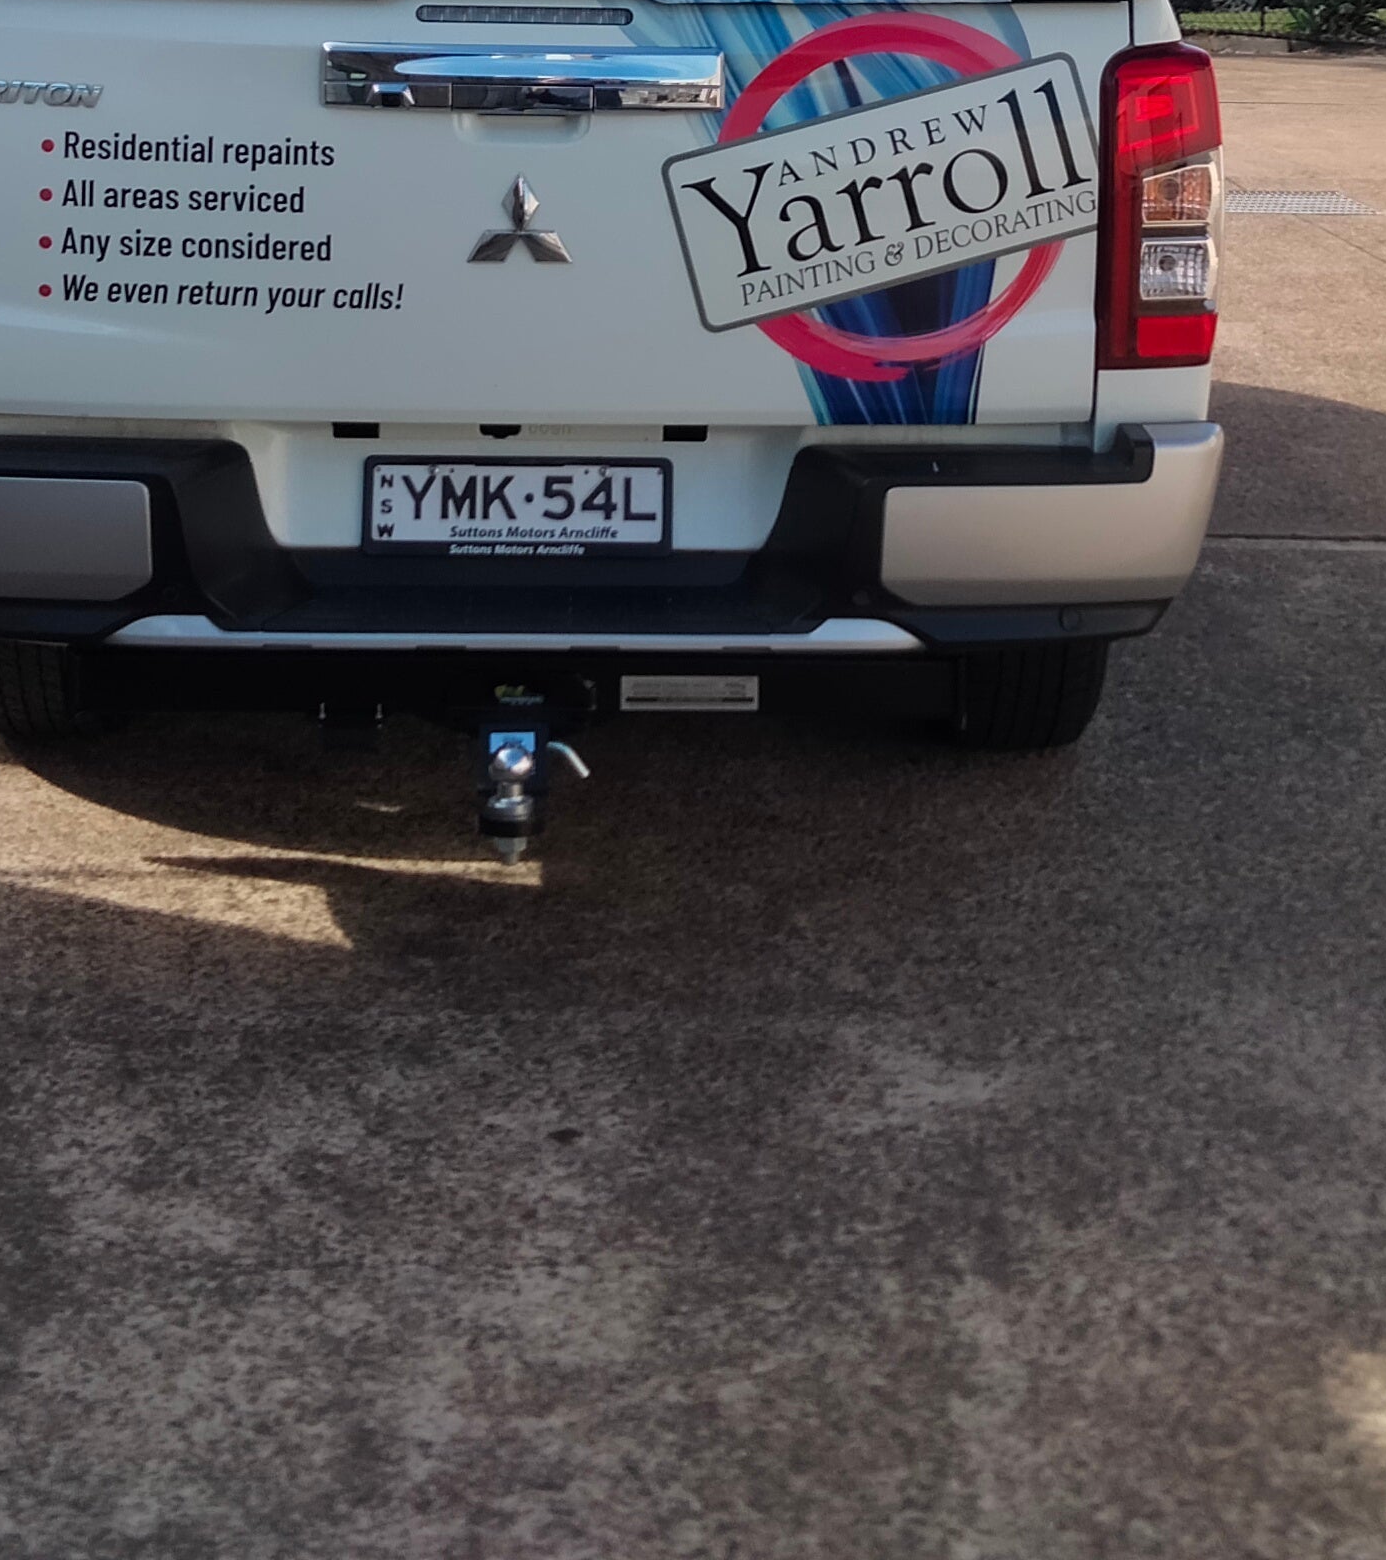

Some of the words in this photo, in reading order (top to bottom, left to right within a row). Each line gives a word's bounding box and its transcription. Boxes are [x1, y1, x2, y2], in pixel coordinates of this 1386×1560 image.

[63, 131, 213, 164] Residential
[222, 138, 335, 171] repaints
[778, 104, 989, 188] ANDREW
[61, 179, 95, 208] All
[103, 187, 180, 210] areas
[188, 185, 305, 214] serviced
[682, 78, 1092, 279] Yarroll
[61, 227, 110, 262] Any
[119, 229, 172, 257] size
[182, 233, 332, 262] considered
[740, 250, 876, 307] PAINTING
[884, 243, 905, 267] &
[915, 190, 1098, 261] DECORATING
[61, 274, 98, 302] We
[107, 283, 168, 304] even
[176, 282, 259, 308] return
[265, 287, 327, 314] your
[332, 282, 404, 310] calls!
[449, 525, 503, 538] Suttons
[505, 526, 555, 539] Motors
[558, 526, 619, 539] Arncliffe
[449, 543, 492, 555] Suttons
[493, 544, 534, 555] Motors
